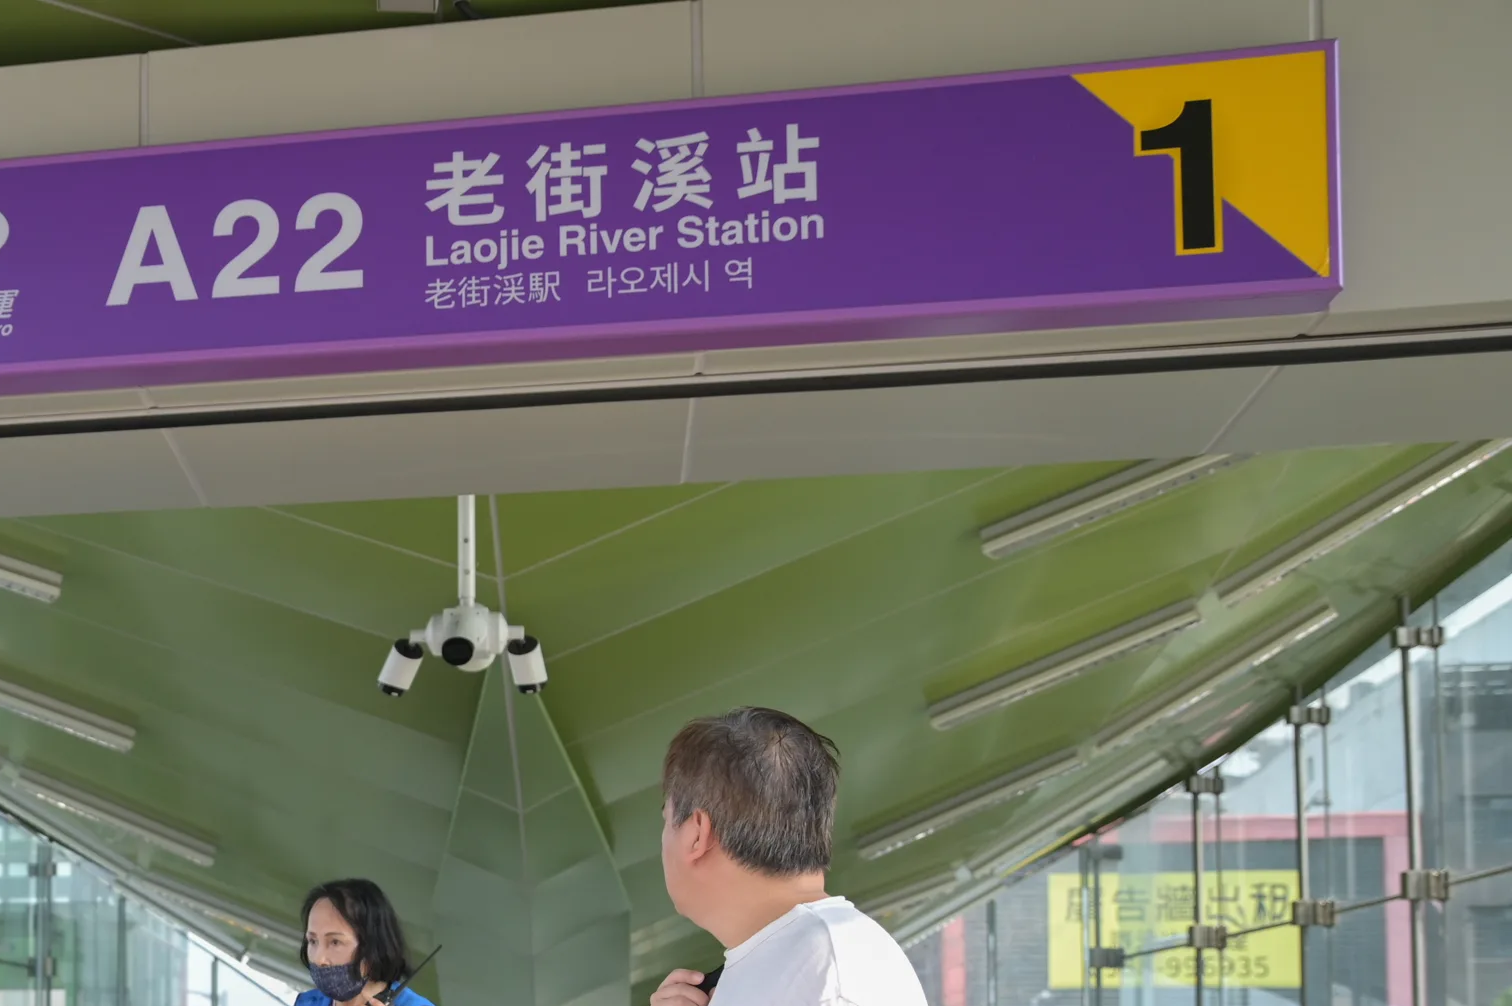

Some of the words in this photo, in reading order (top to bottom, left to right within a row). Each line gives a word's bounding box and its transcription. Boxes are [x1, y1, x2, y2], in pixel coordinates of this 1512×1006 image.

[425, 123, 820, 226] 老街溪站
[1140, 98, 1216, 251] 1
[105, 192, 364, 307] A22
[425, 229, 545, 269] Laojie
[559, 223, 664, 257] River
[677, 210, 825, 249] Station
[587, 260, 710, 299] 라오제시
[724, 256, 754, 290] 역
